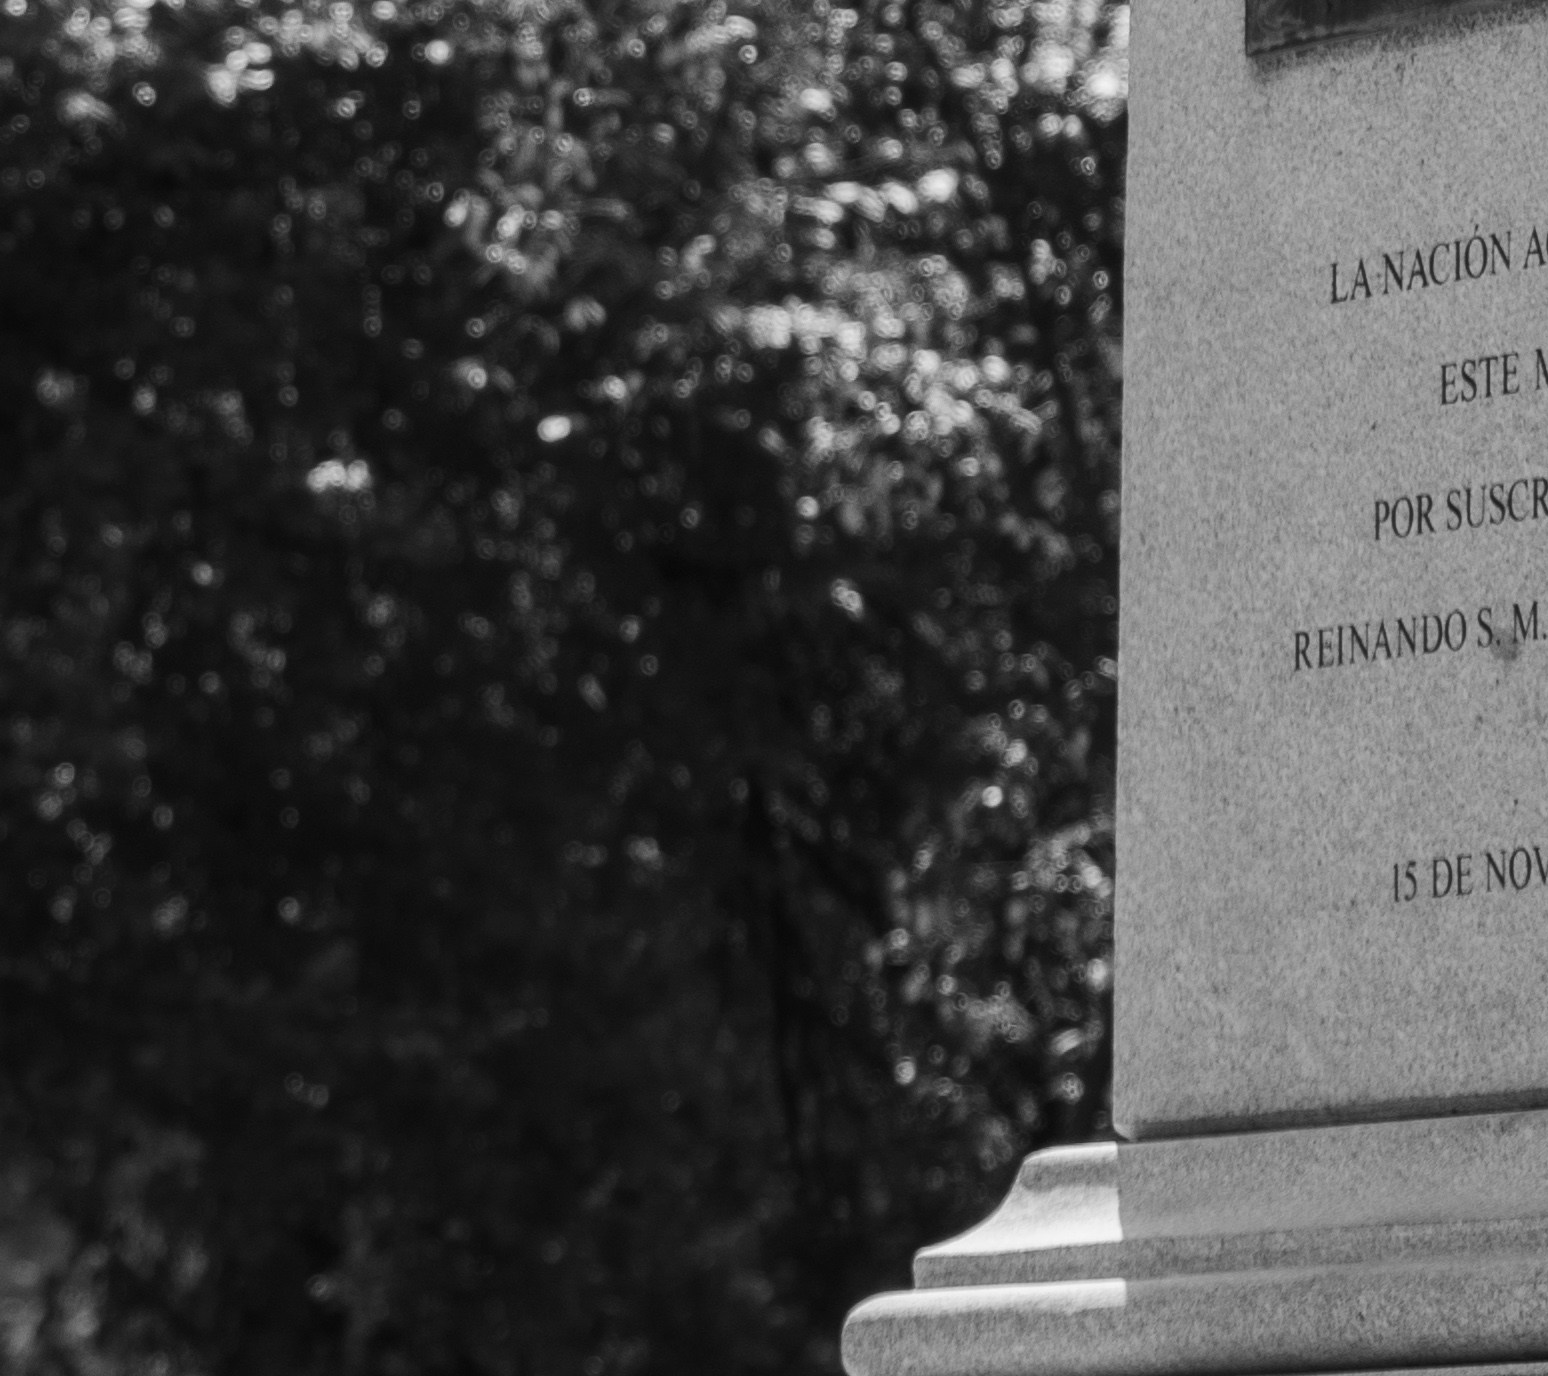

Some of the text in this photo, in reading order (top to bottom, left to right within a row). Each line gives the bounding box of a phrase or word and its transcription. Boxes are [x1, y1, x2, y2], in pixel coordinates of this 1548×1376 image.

[1329, 258, 1373, 305] LA
[1381, 224, 1512, 295] NACIÓN
[1440, 352, 1520, 406] ESTE
[1374, 493, 1436, 542] POR
[1293, 609, 1468, 672] REINANDO
[1476, 606, 1504, 651] S.
[1509, 600, 1548, 645] M.
[1393, 859, 1418, 903] 15
[1431, 854, 1472, 899] DE
